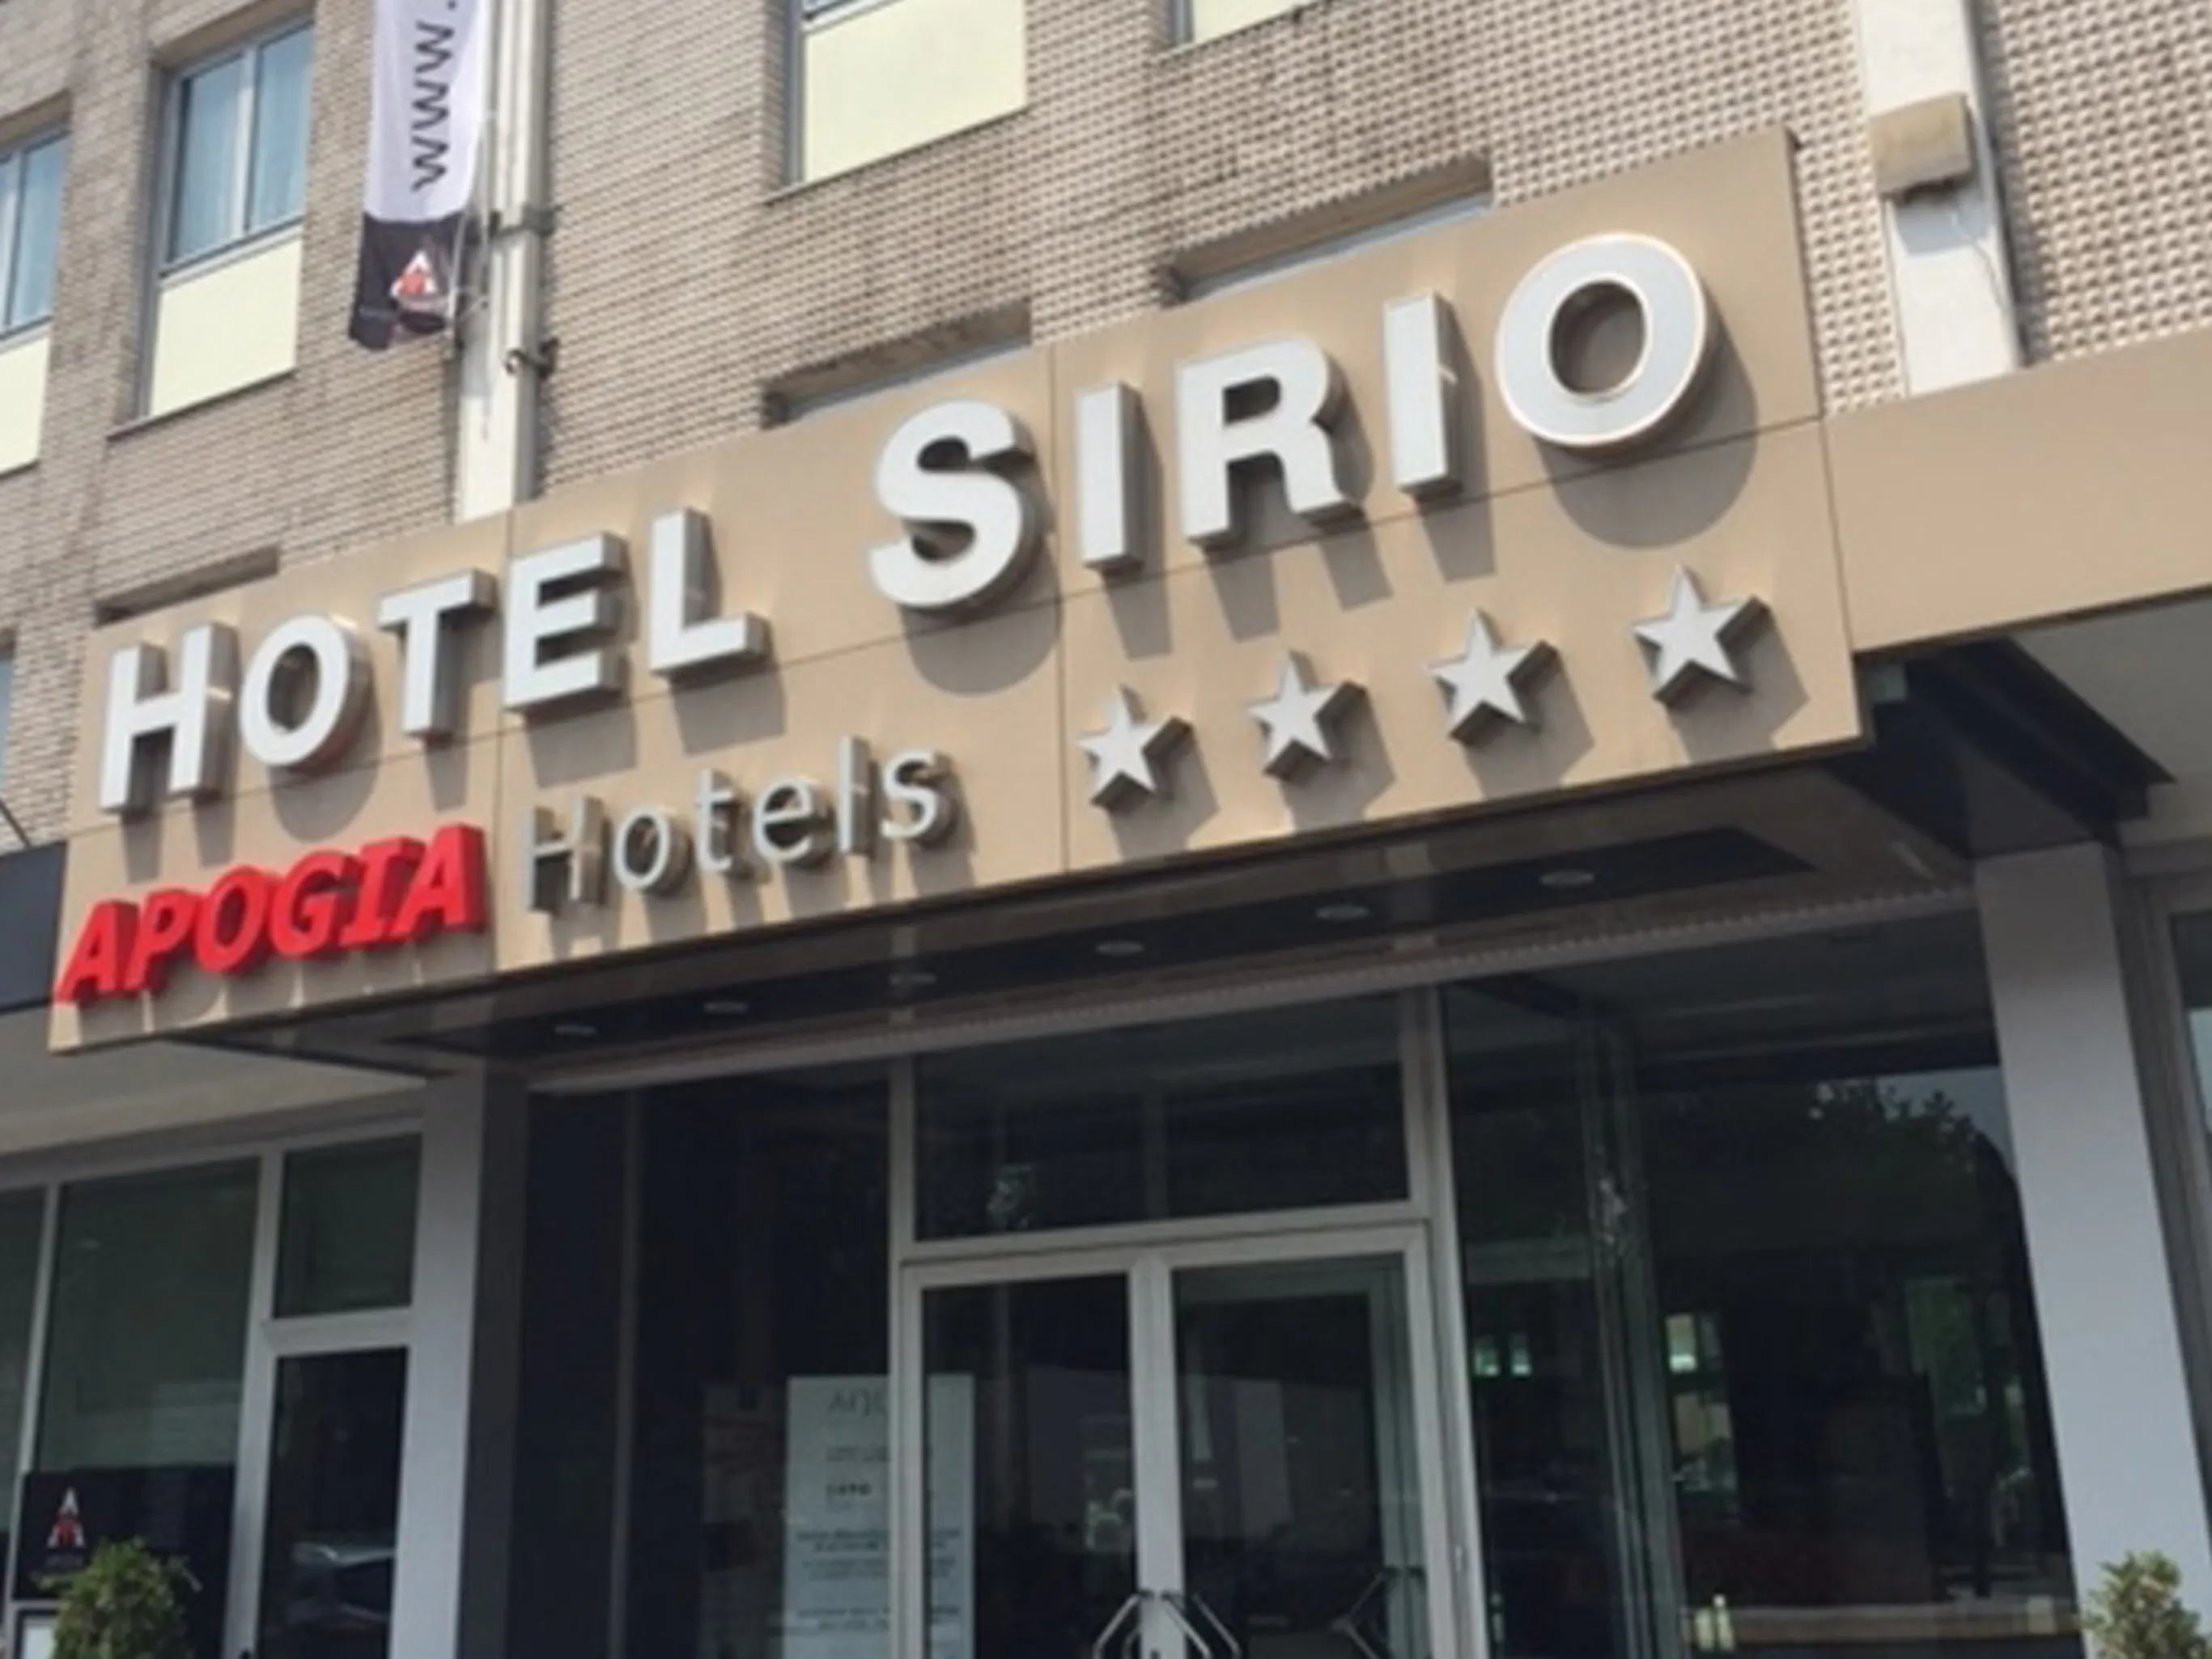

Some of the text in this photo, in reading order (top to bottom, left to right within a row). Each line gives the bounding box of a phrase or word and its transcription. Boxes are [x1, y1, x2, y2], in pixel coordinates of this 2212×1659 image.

[100, 232, 1709, 813] HOTEL SIRIO
[54, 735, 951, 1003] APOGIA Hotels
